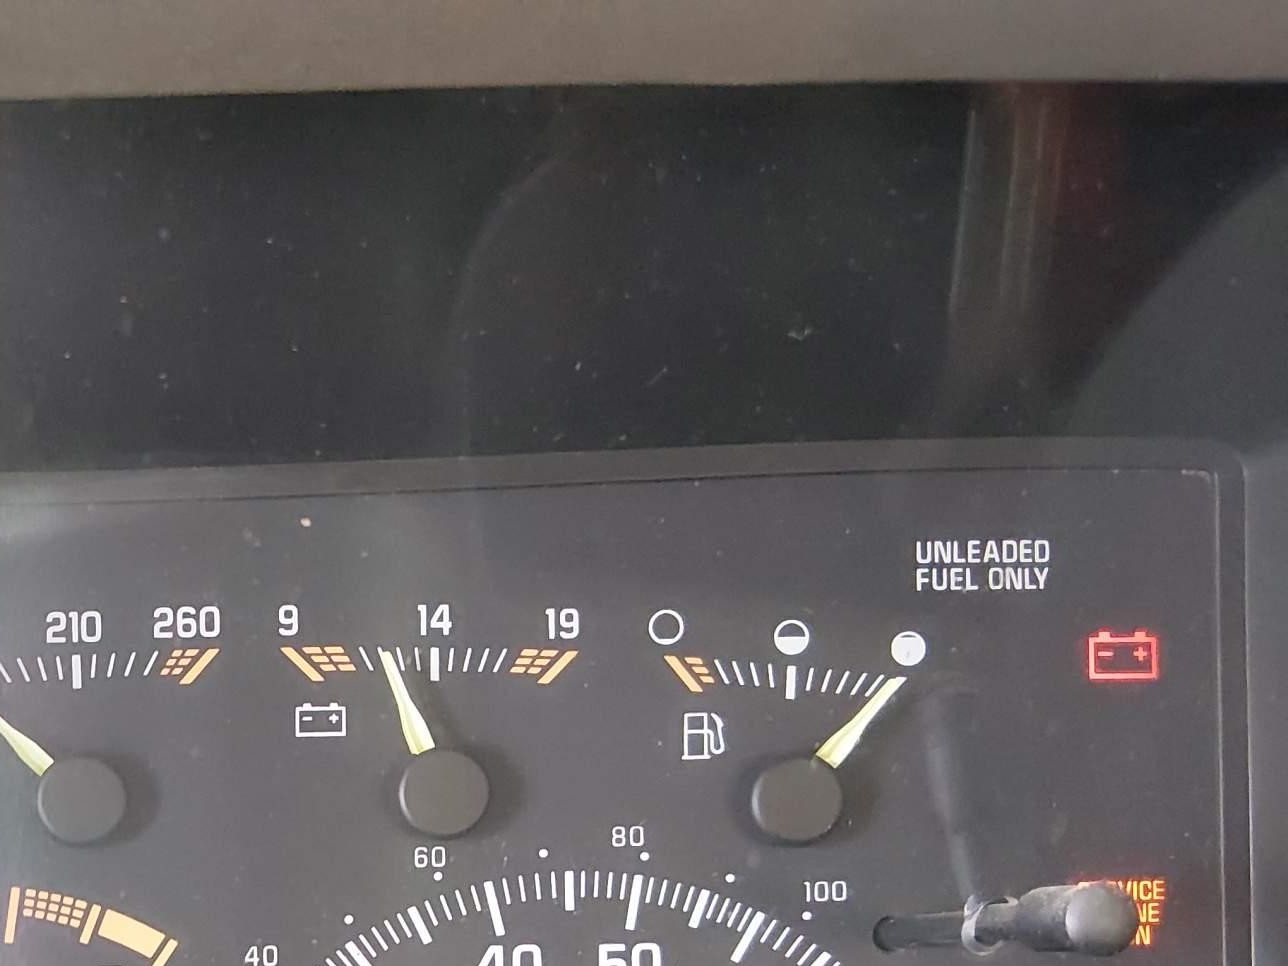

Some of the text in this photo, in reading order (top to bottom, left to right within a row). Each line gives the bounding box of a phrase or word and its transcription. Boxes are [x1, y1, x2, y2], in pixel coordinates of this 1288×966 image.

[915, 539, 1051, 564] UNLEADED
[915, 566, 1050, 592] FUEL ONLY
[45, 610, 103, 644] 210
[153, 605, 221, 639] 260
[278, 604, 300, 636] 9
[416, 603, 453, 636] 14
[544, 607, 580, 640] 19
[611, 825, 645, 848] 80
[414, 846, 447, 868] 60
[803, 880, 847, 903] 100
